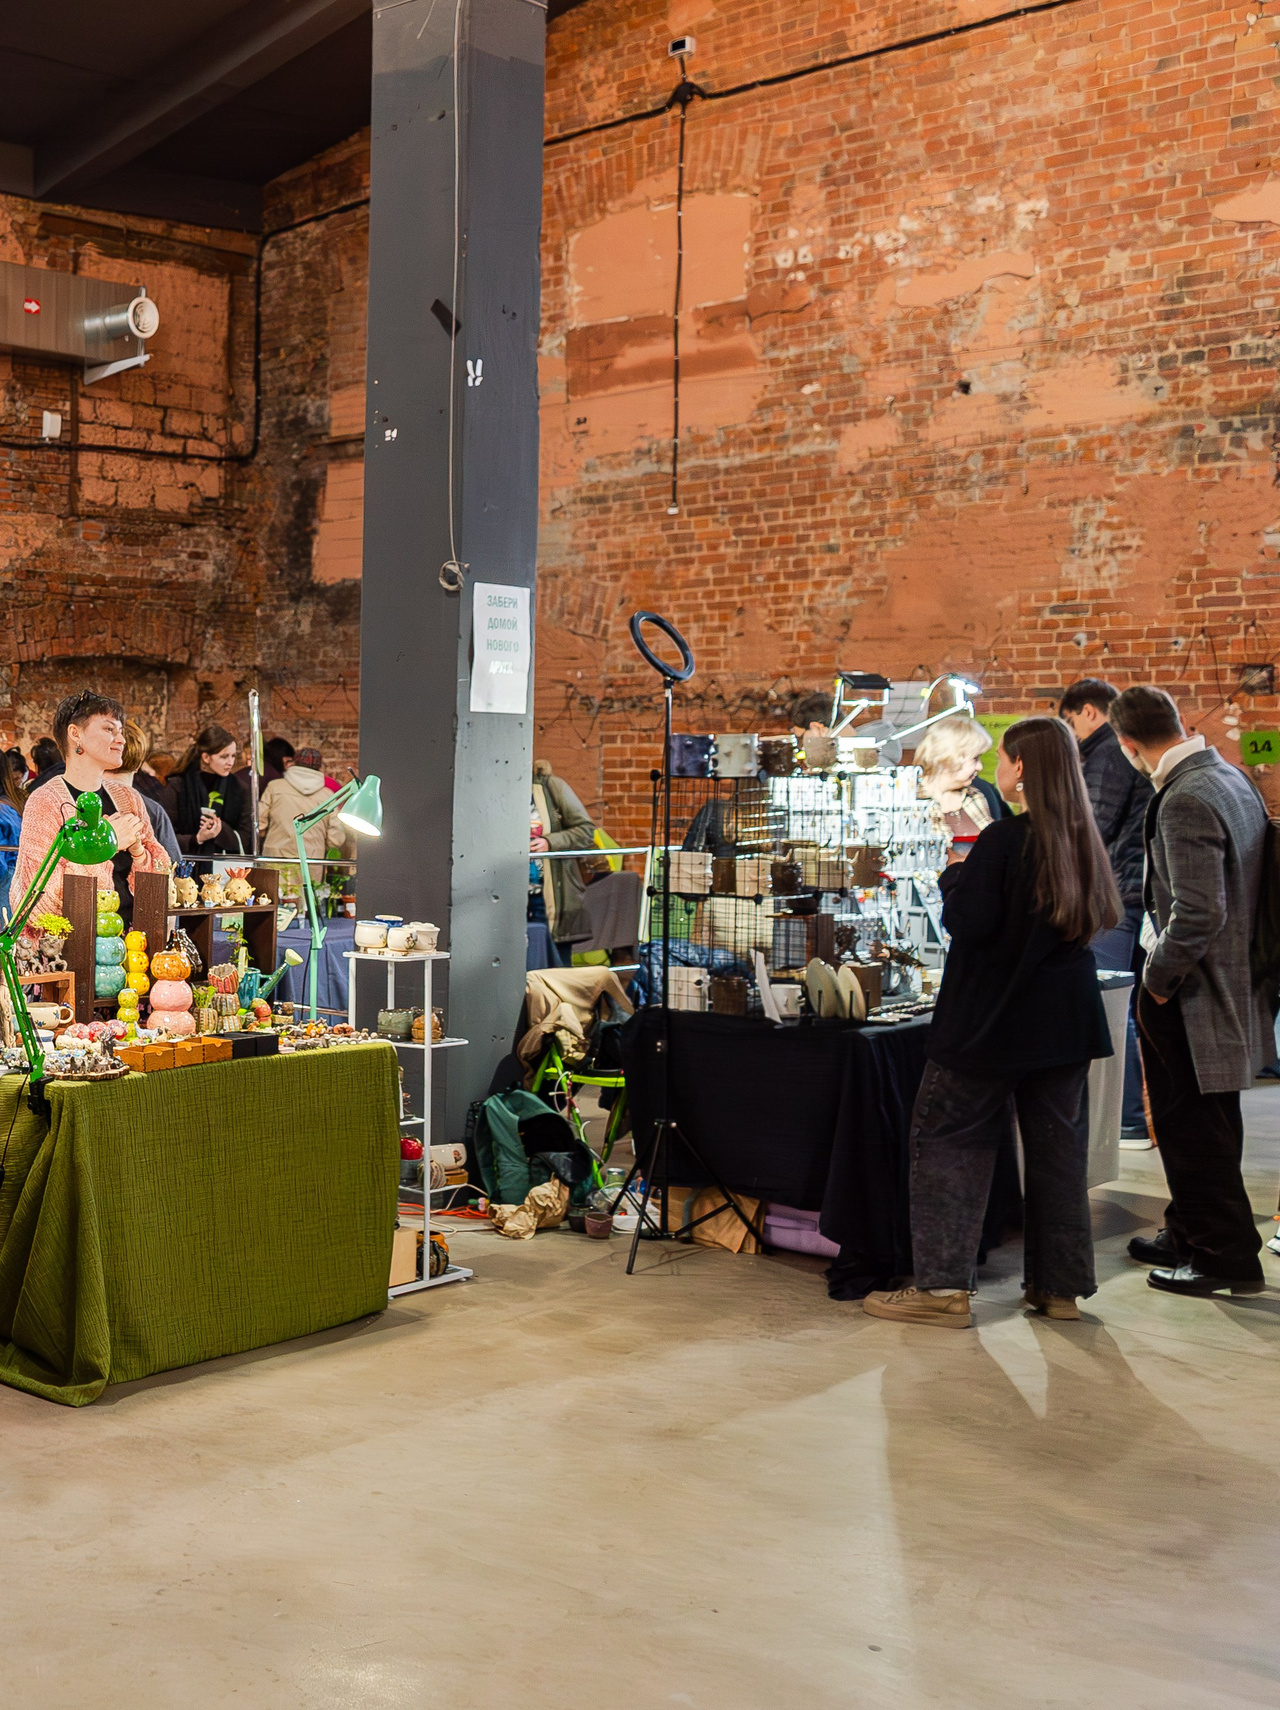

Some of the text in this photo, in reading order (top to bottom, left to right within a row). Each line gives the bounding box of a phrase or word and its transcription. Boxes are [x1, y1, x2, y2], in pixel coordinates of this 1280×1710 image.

[486, 595, 518, 609] ЗАБЕРИ
[487, 617, 518, 631] ДОМОЙ
[486, 638, 519, 652] НОВОГО
